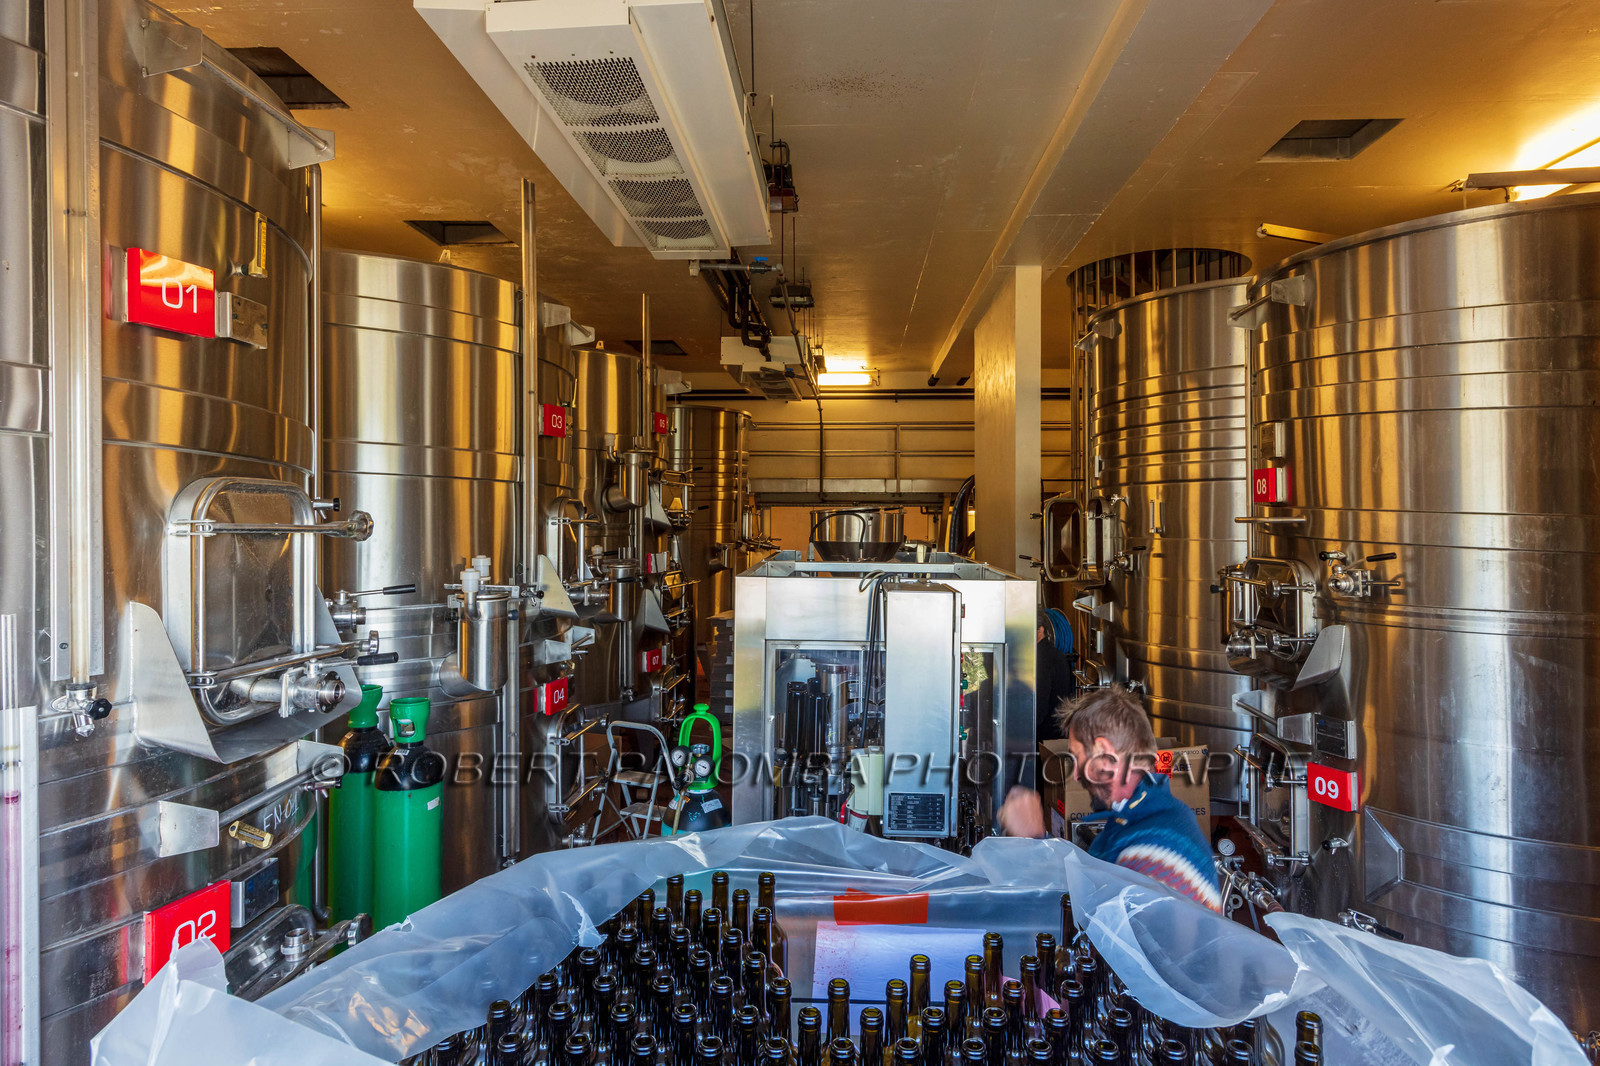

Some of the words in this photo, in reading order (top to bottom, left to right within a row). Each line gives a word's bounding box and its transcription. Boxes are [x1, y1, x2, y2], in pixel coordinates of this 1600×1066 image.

[161, 277, 198, 313] 01
[551, 414, 563, 430] 03
[1256, 478, 1267, 495] 08
[652, 655, 659, 666] 07
[553, 687, 565, 704] 04
[1314, 776, 1339, 799] 09
[175, 910, 216, 946] 02
